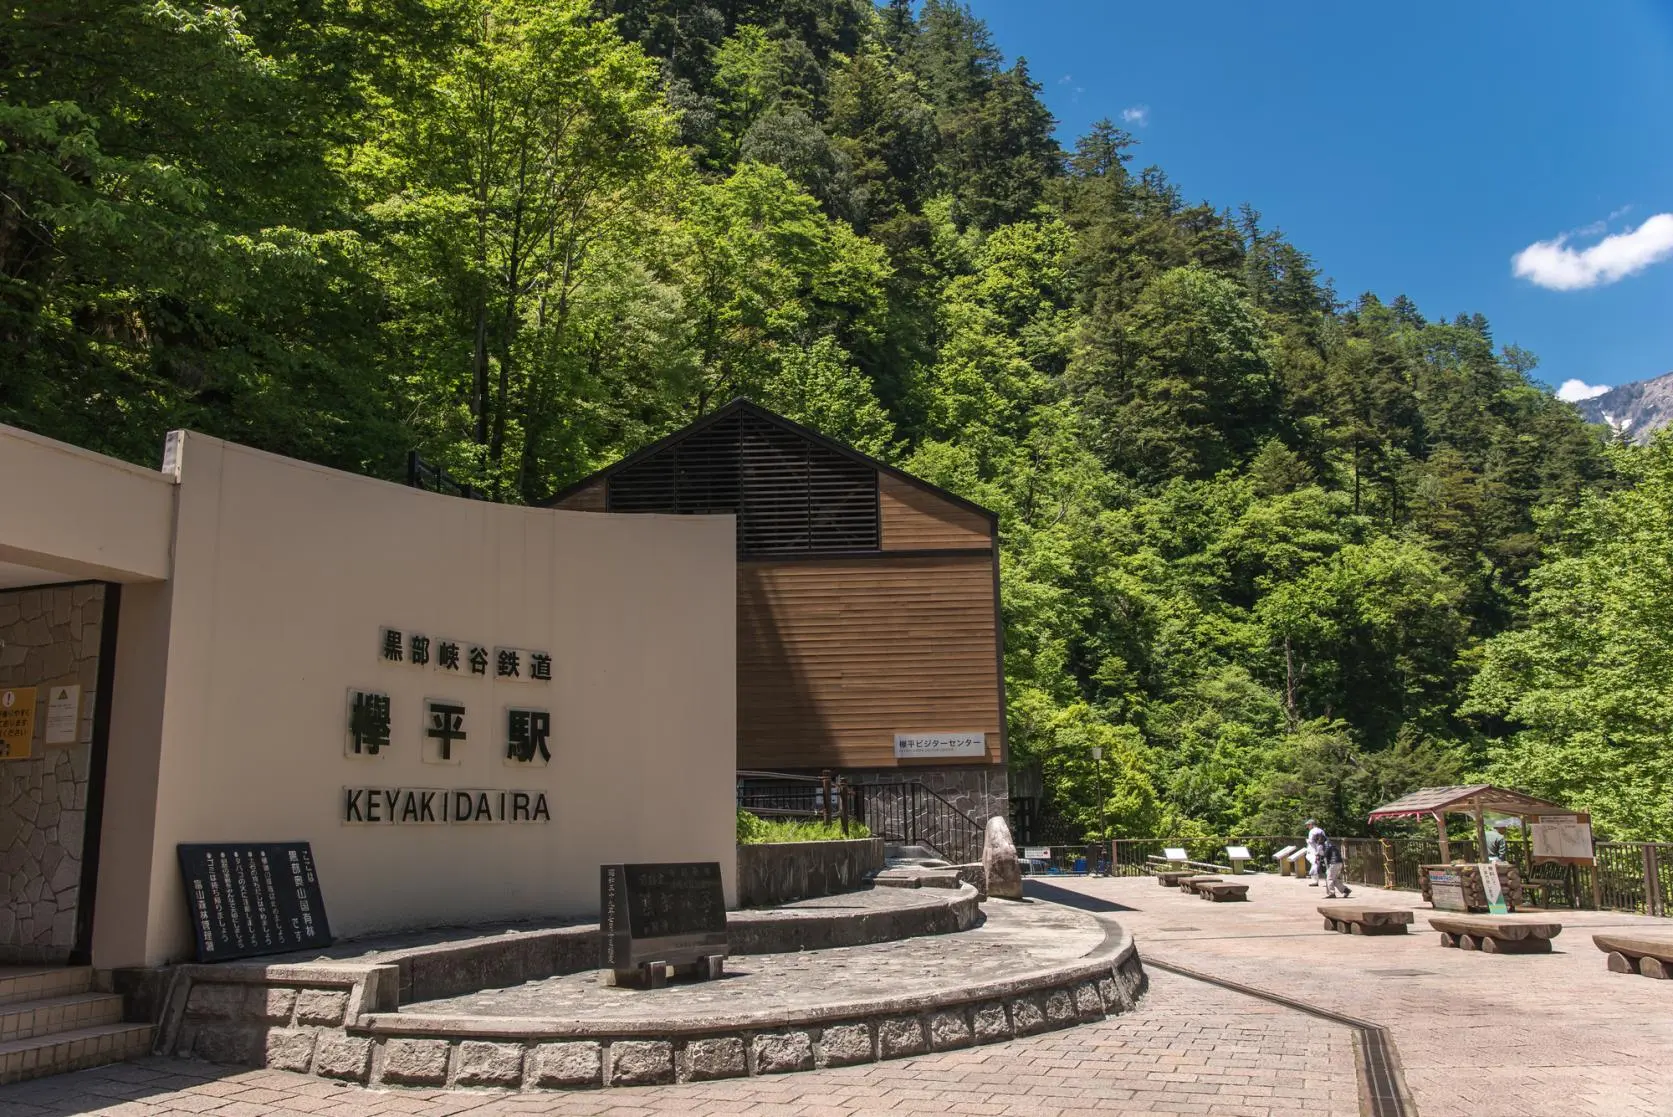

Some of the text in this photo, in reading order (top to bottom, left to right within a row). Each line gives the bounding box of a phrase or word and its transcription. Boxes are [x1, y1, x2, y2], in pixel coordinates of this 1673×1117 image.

[384, 630, 552, 681] 黒部峡谷鉄道
[351, 692, 551, 763] 欅平駅
[346, 789, 551, 822] KEYAKIDAIRA
